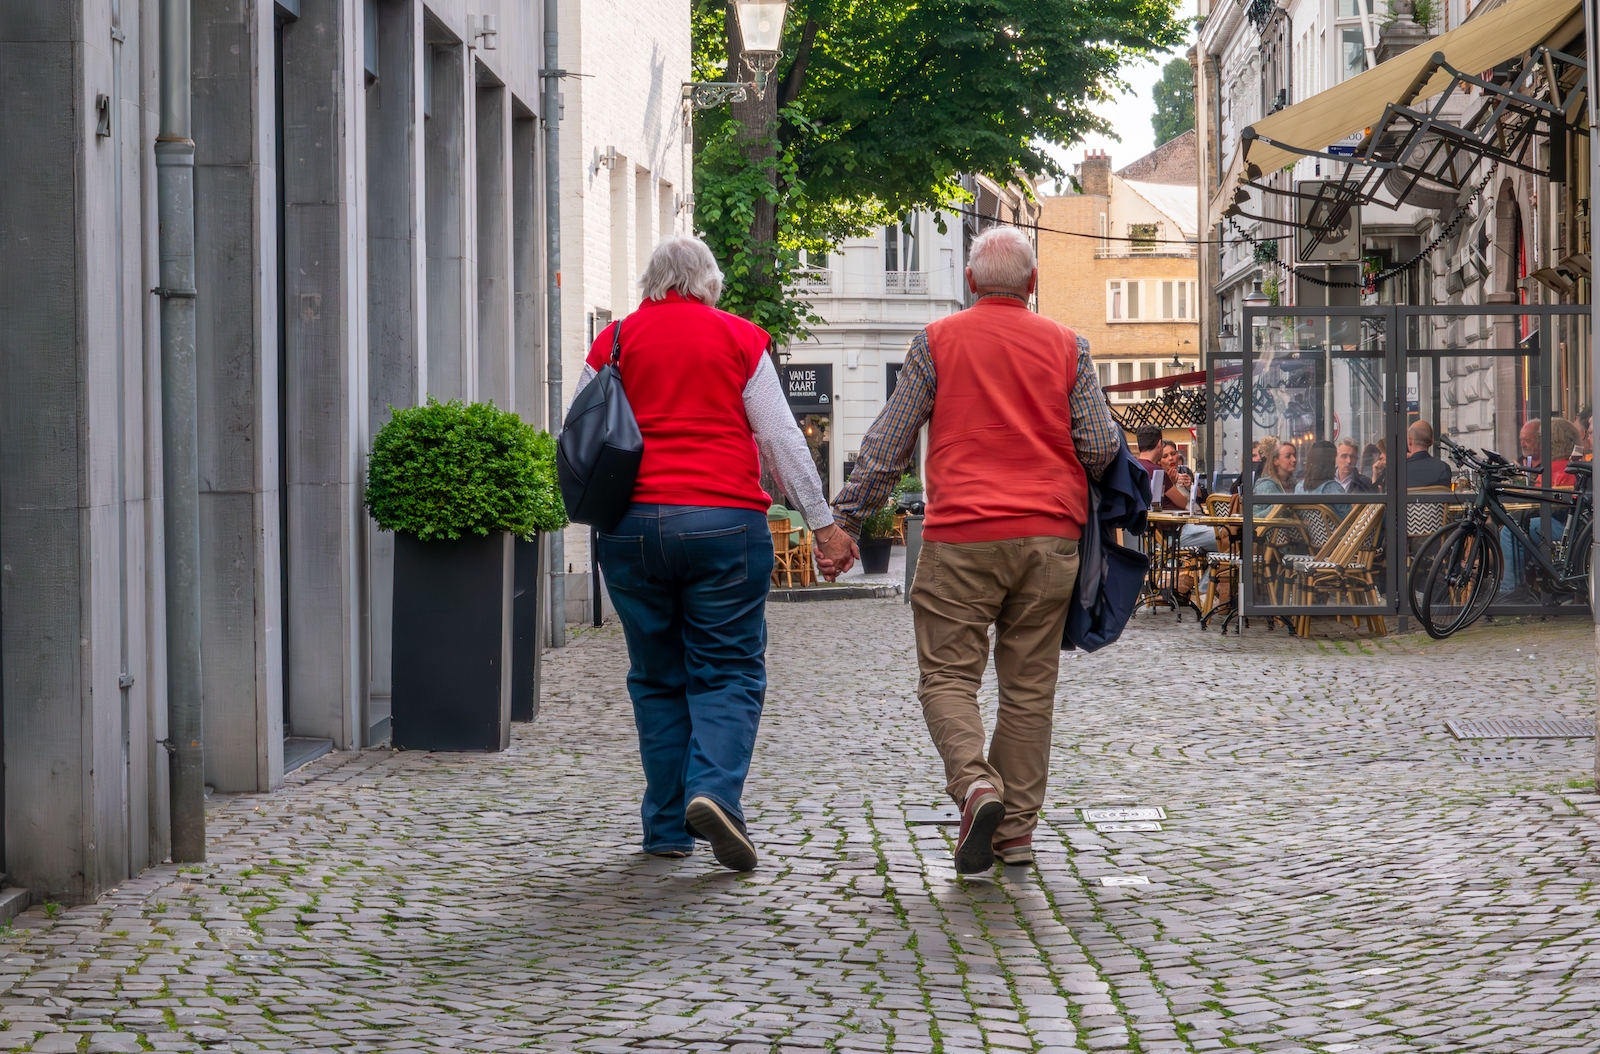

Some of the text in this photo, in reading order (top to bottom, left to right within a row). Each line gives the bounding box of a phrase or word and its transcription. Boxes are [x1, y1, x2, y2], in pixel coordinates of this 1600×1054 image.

[789, 370, 816, 380] VAN DE
[789, 381, 816, 391] KAART
